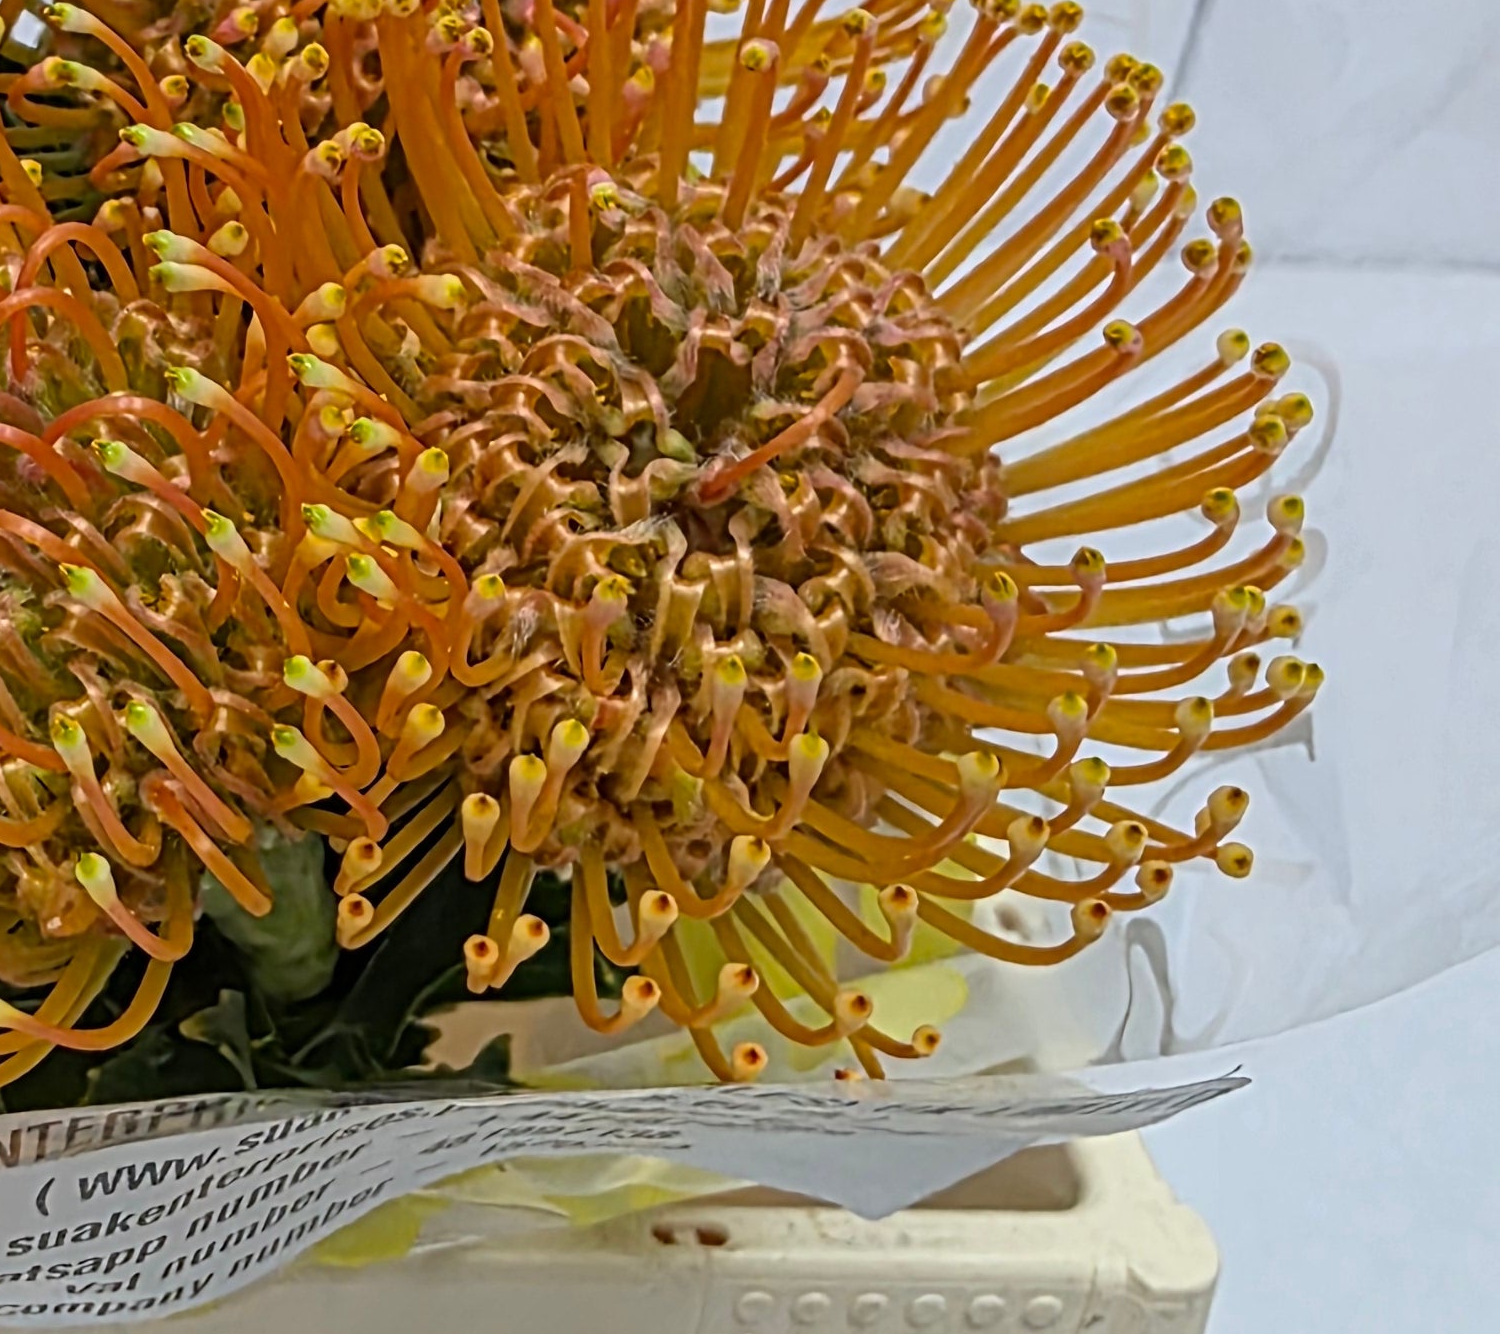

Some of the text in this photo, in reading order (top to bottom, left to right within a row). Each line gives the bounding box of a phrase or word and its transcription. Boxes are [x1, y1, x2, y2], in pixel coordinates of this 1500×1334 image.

[161, 1178, 337, 1283] number
[185, 1139, 373, 1241] number
[228, 1177, 395, 1278] number
